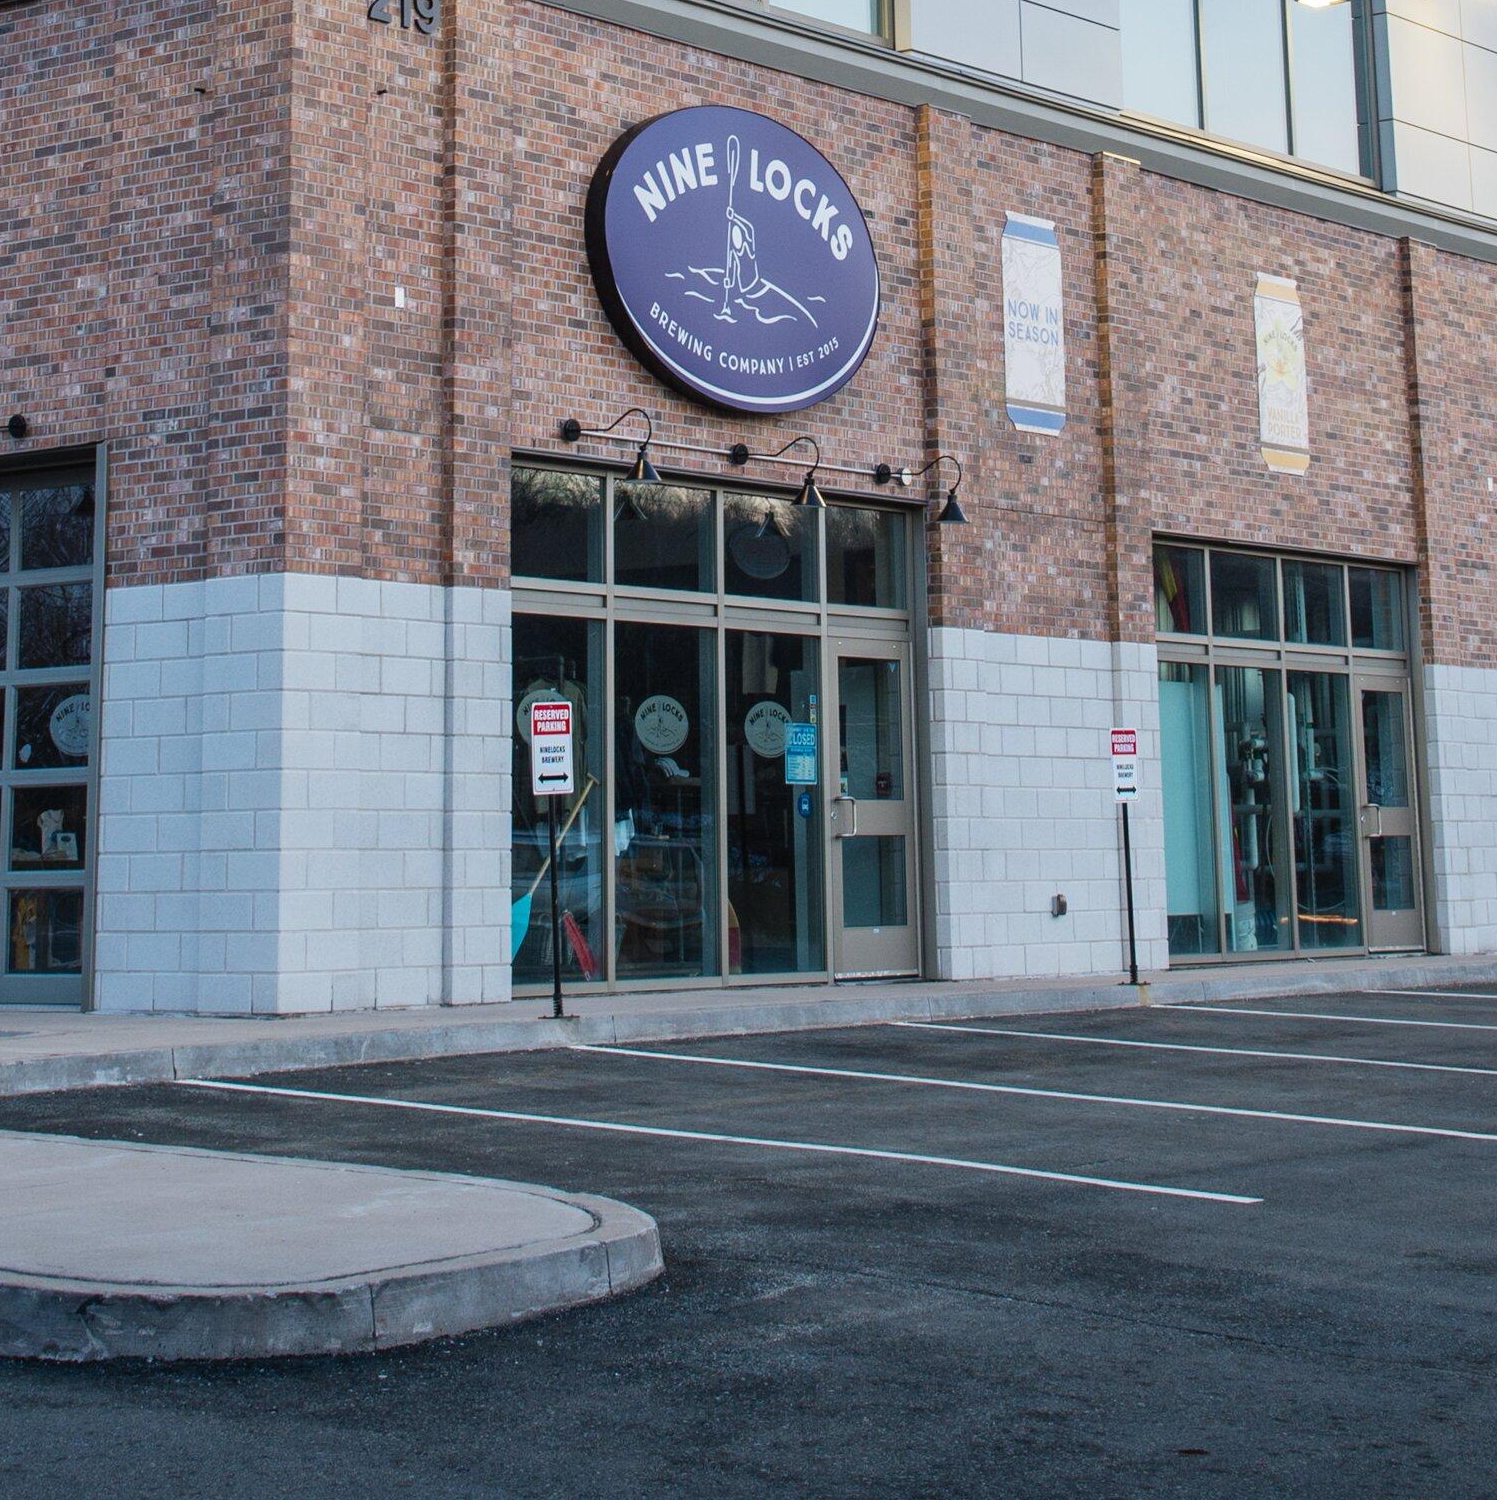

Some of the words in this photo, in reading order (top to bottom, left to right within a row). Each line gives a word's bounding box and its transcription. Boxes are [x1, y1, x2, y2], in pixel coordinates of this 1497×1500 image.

[633, 143, 718, 223] NINE
[750, 149, 853, 261] LOCKS
[1008, 300, 1039, 321] NOW
[1045, 306, 1058, 325] IN
[650, 302, 712, 362] BREWING
[719, 352, 784, 375] COMPANY
[797, 351, 814, 368] EST
[818, 336, 839, 360] 2015
[1008, 321, 1059, 346] SEASON
[1268, 422, 1302, 440] PORTER
[534, 709, 569, 721] RESERVED
[537, 721, 567, 733] PARKING
[1112, 734, 1135, 743] RESERVED
[1114, 743, 1134, 753] PARKING
[542, 756, 565, 764] BREWERY
